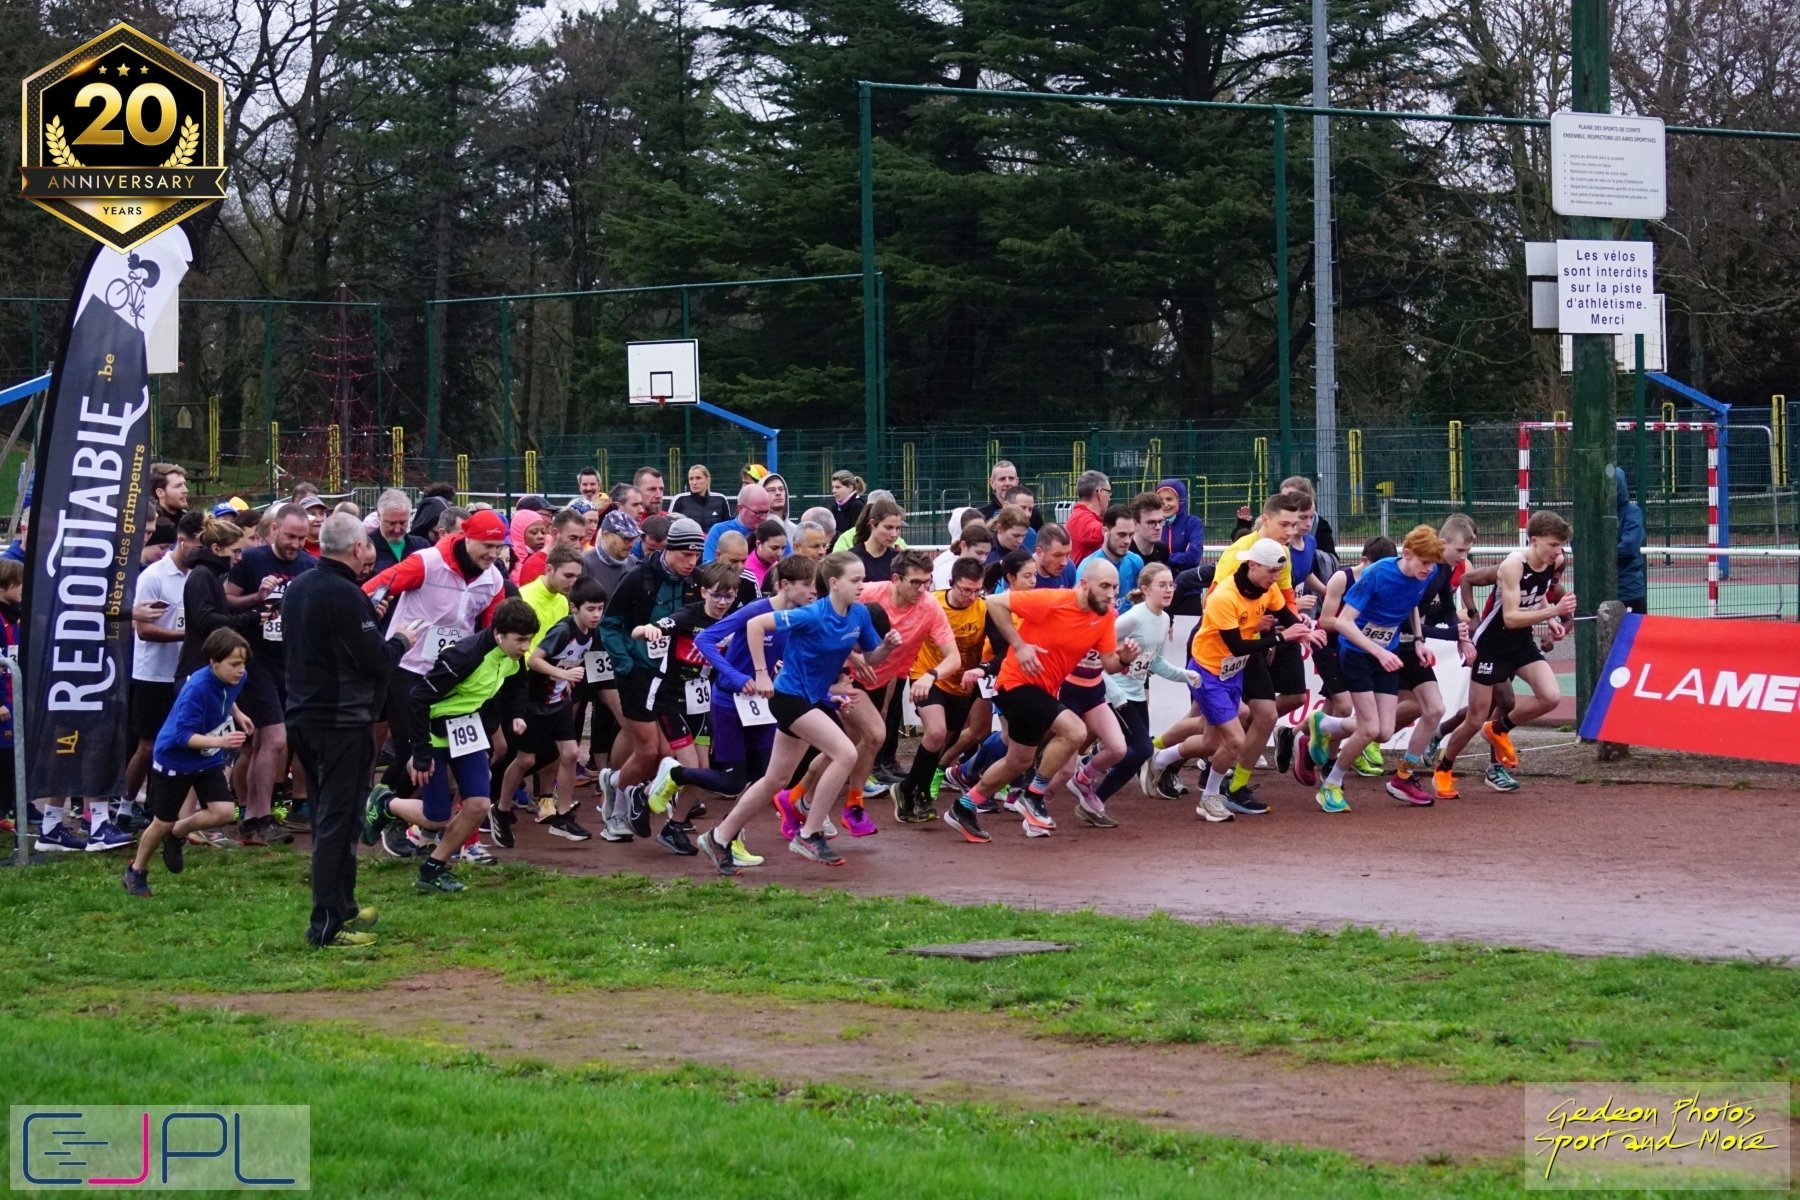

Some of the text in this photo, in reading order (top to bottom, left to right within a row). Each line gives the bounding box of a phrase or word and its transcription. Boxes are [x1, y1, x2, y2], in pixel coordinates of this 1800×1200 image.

[1576, 249, 1636, 262] Les vélos
[1563, 266, 1648, 278] sont interdits
[1570, 282, 1642, 296] sur la piste
[1566, 297, 1647, 310] d'athlétisme.
[1591, 313, 1625, 325] Merci
[97, 353, 115, 382] .be
[46, 384, 149, 711] REDOUTABLE
[105, 444, 145, 640] La bière des grimpeurs
[177, 616, 185, 628] 3
[265, 621, 283, 633] 38
[437, 627, 463, 638] CJPL
[1363, 627, 1394, 642] 3653
[595, 657, 614, 674] 33
[1134, 660, 1153, 672] 34
[1222, 658, 1247, 675] 3401
[695, 686, 710, 705] 39
[1633, 663, 1800, 713] LAME
[749, 700, 761, 716] 8
[55, 730, 79, 754] LA
[451, 724, 479, 747] 199
